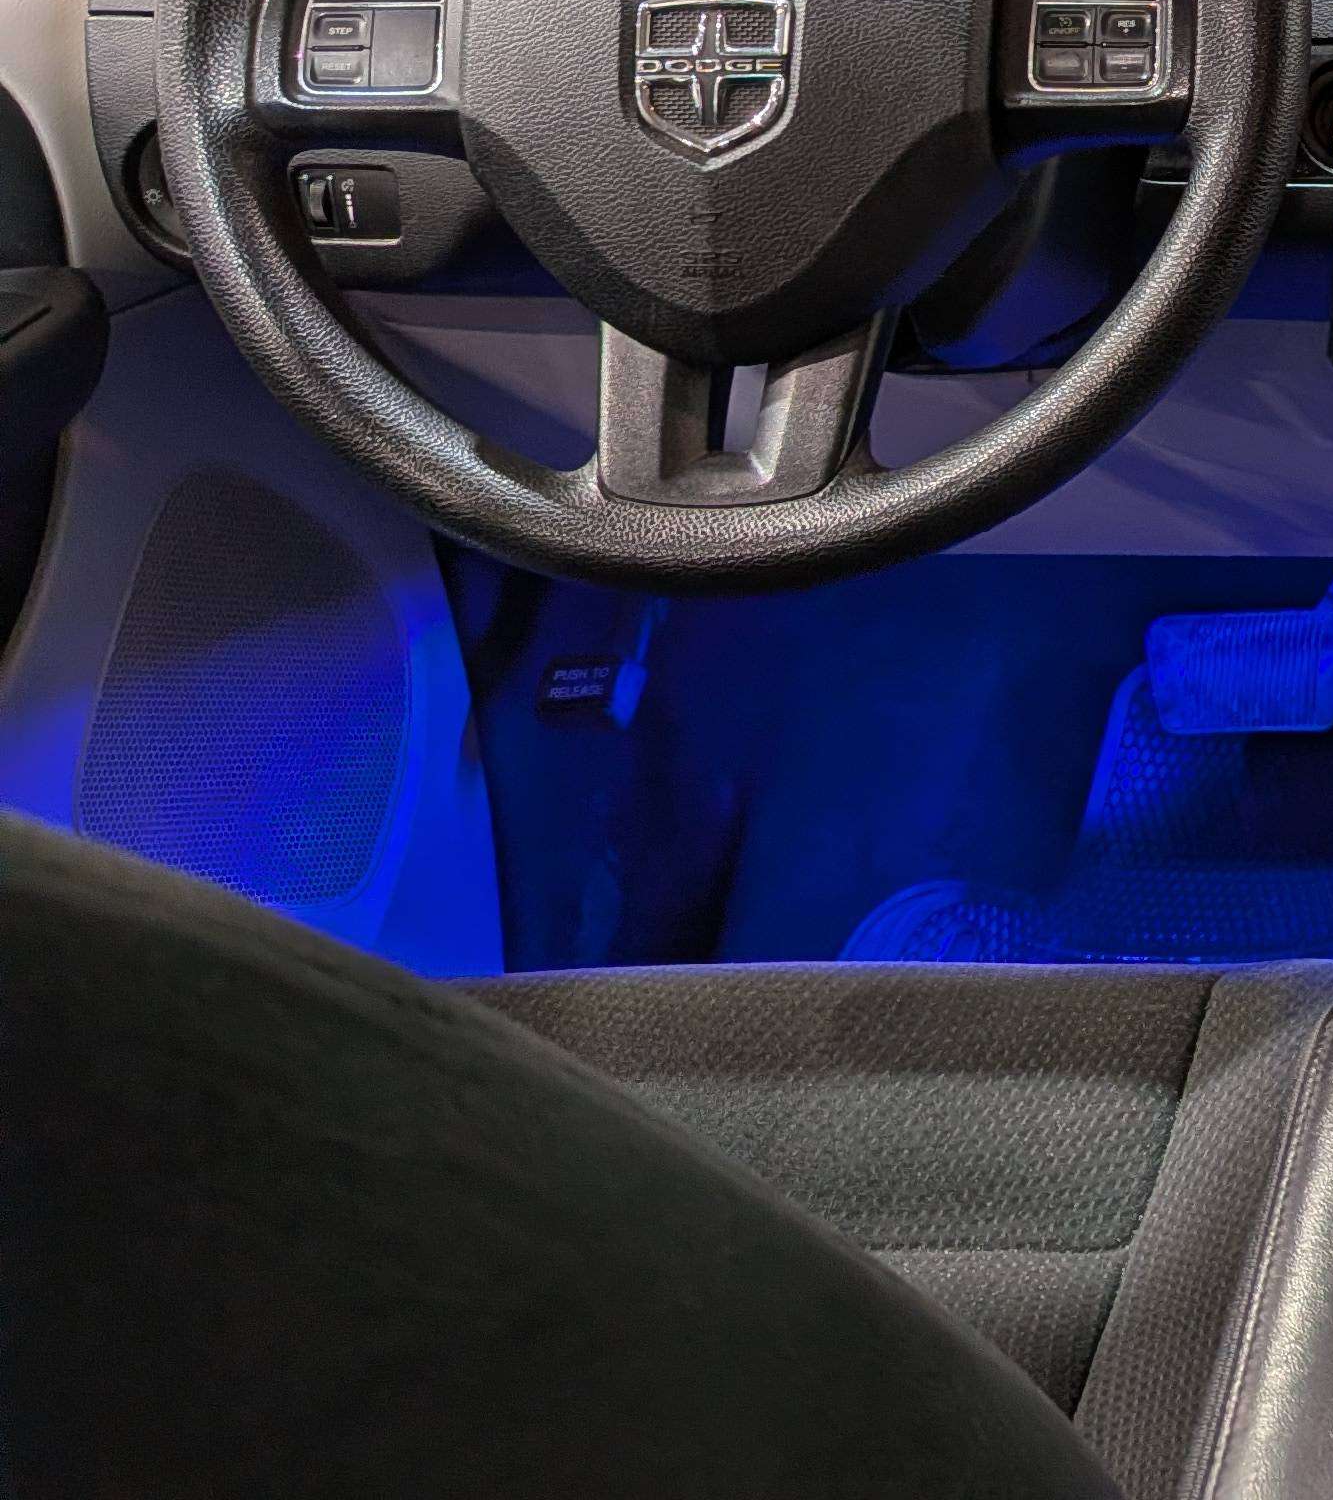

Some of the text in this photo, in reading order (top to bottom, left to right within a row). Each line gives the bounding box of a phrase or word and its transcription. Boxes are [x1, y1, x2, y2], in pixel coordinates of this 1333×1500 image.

[328, 27, 353, 35] STEP
[553, 667, 610, 681] PUSH TO
